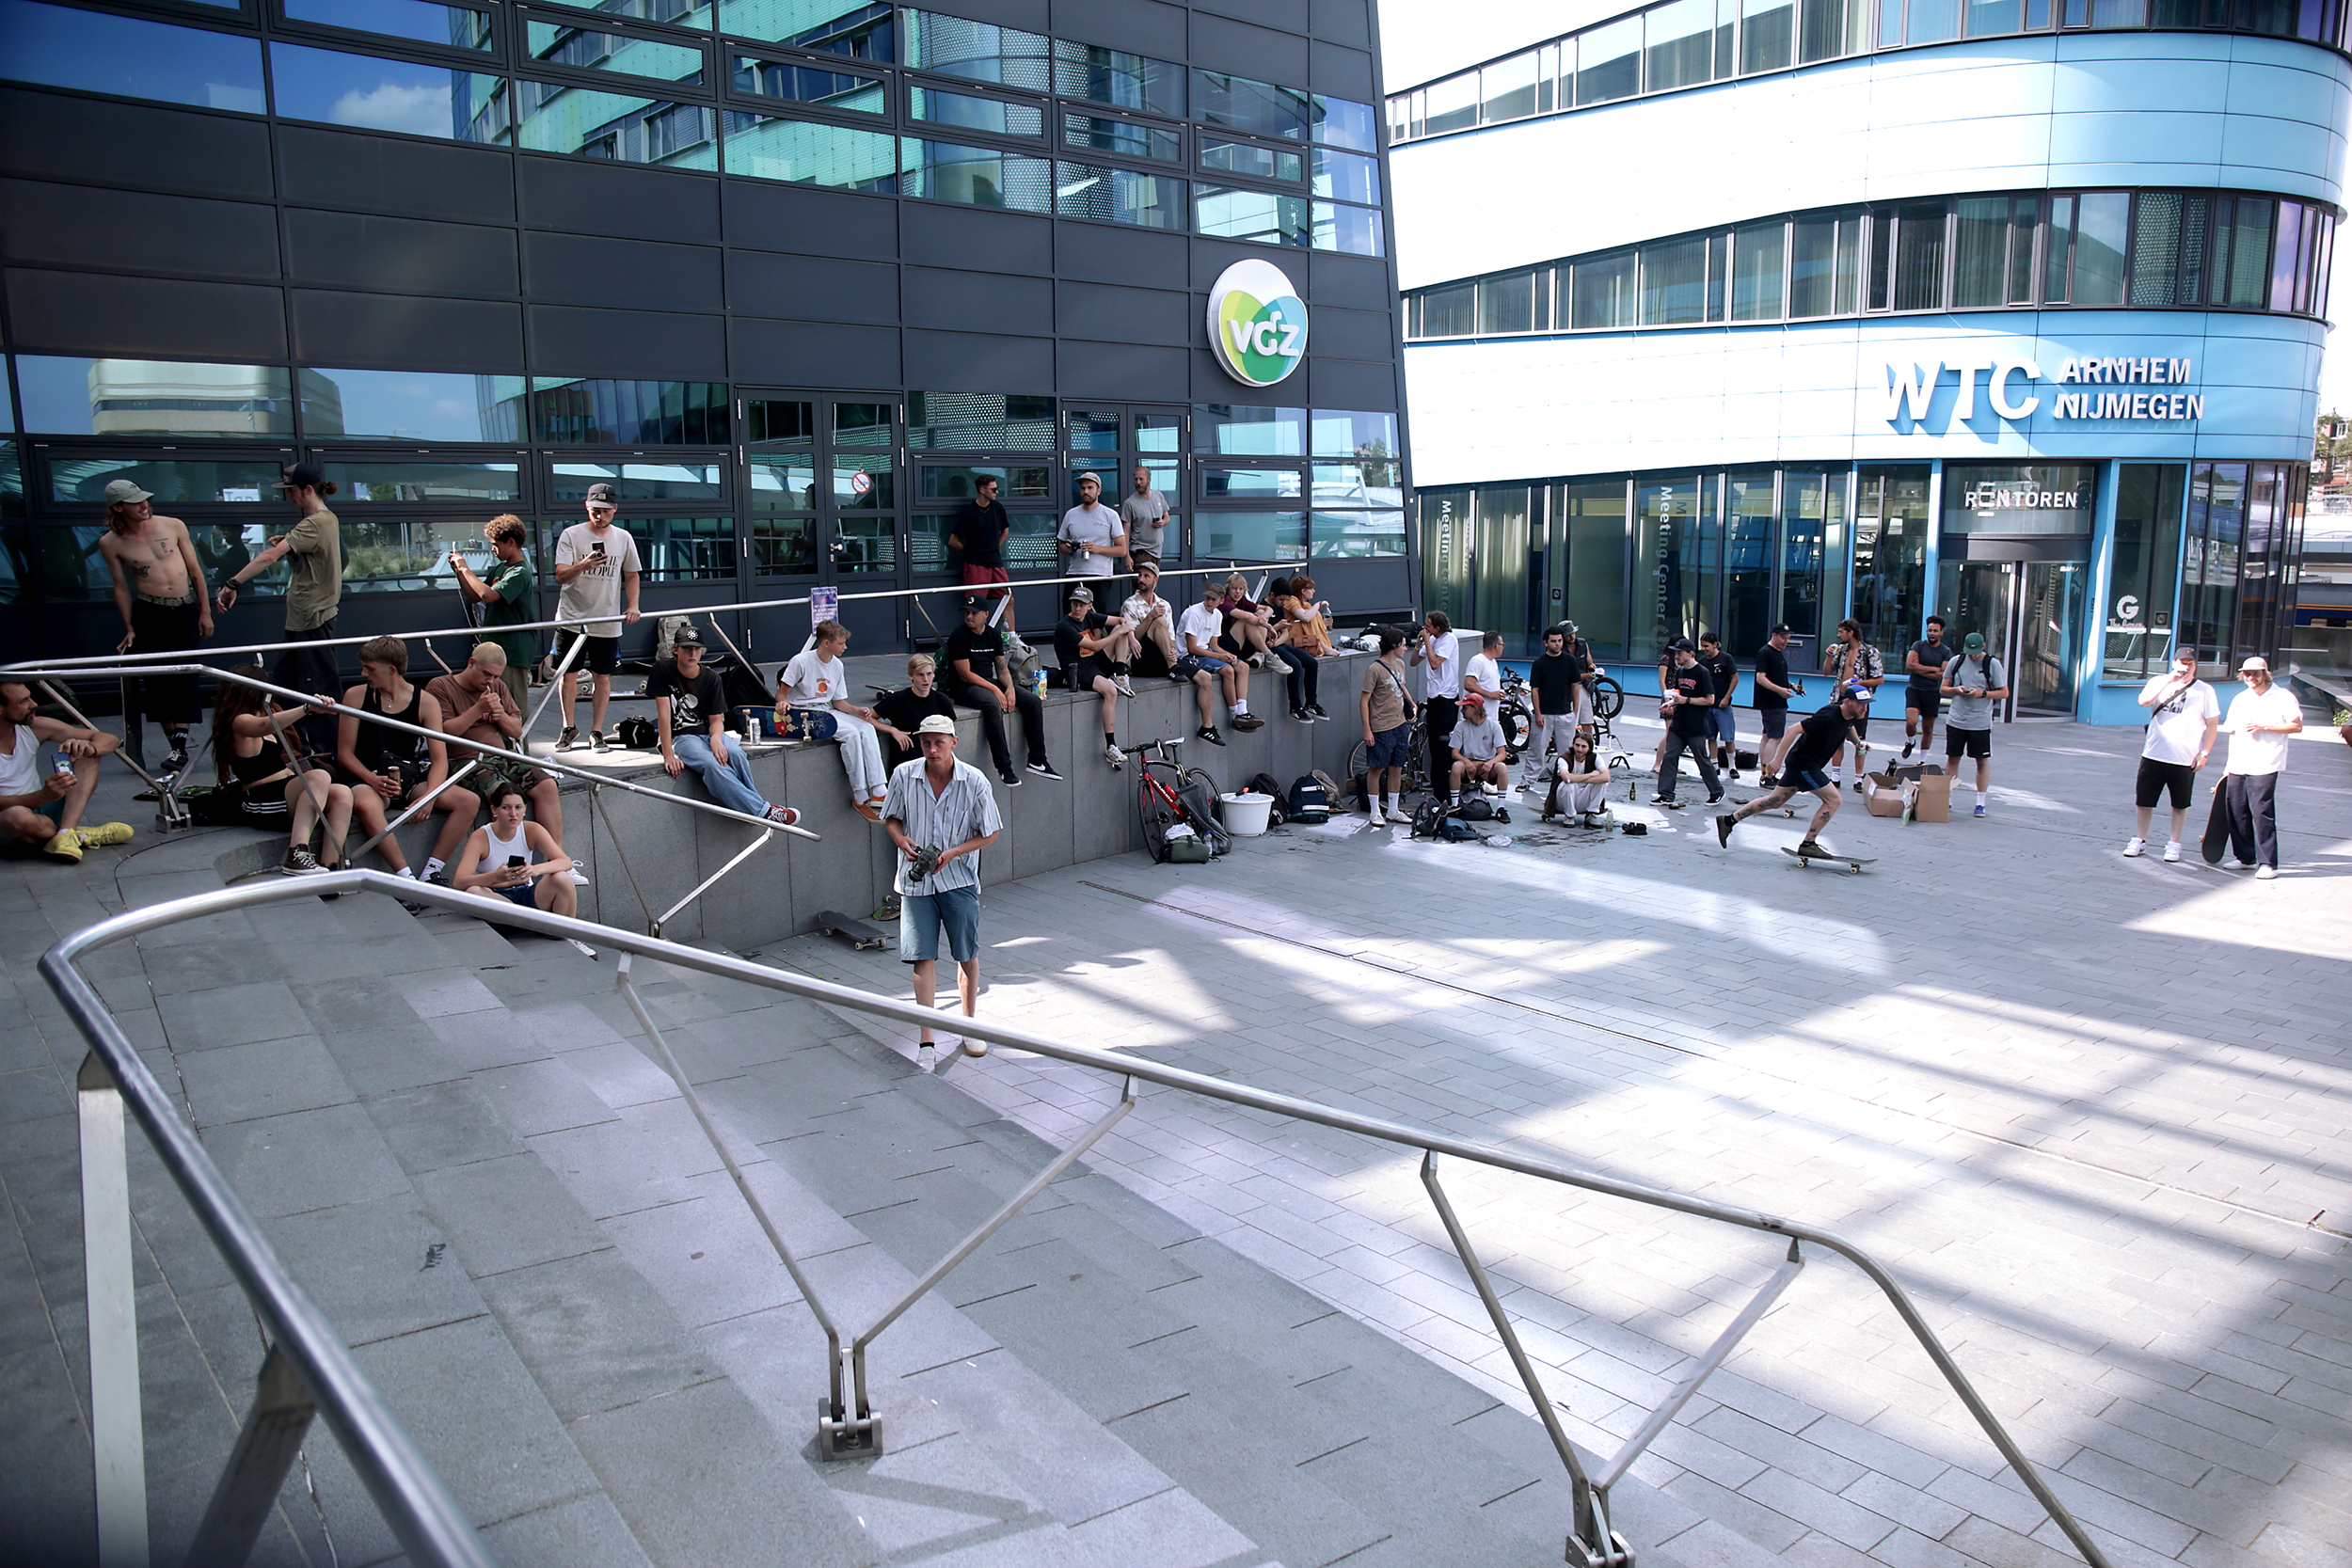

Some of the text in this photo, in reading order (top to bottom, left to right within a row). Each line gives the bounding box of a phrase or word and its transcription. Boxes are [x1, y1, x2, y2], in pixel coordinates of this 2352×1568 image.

[1228, 310, 1300, 356] VGZ
[1883, 357, 2041, 420] WTC
[2059, 356, 2191, 384] ARNHEM
[2056, 392, 2205, 420] NIJMEGEN
[1440, 500, 1452, 562] Meeting
[1656, 486, 1673, 621] Meeting Center
[2116, 594, 2140, 620] G
